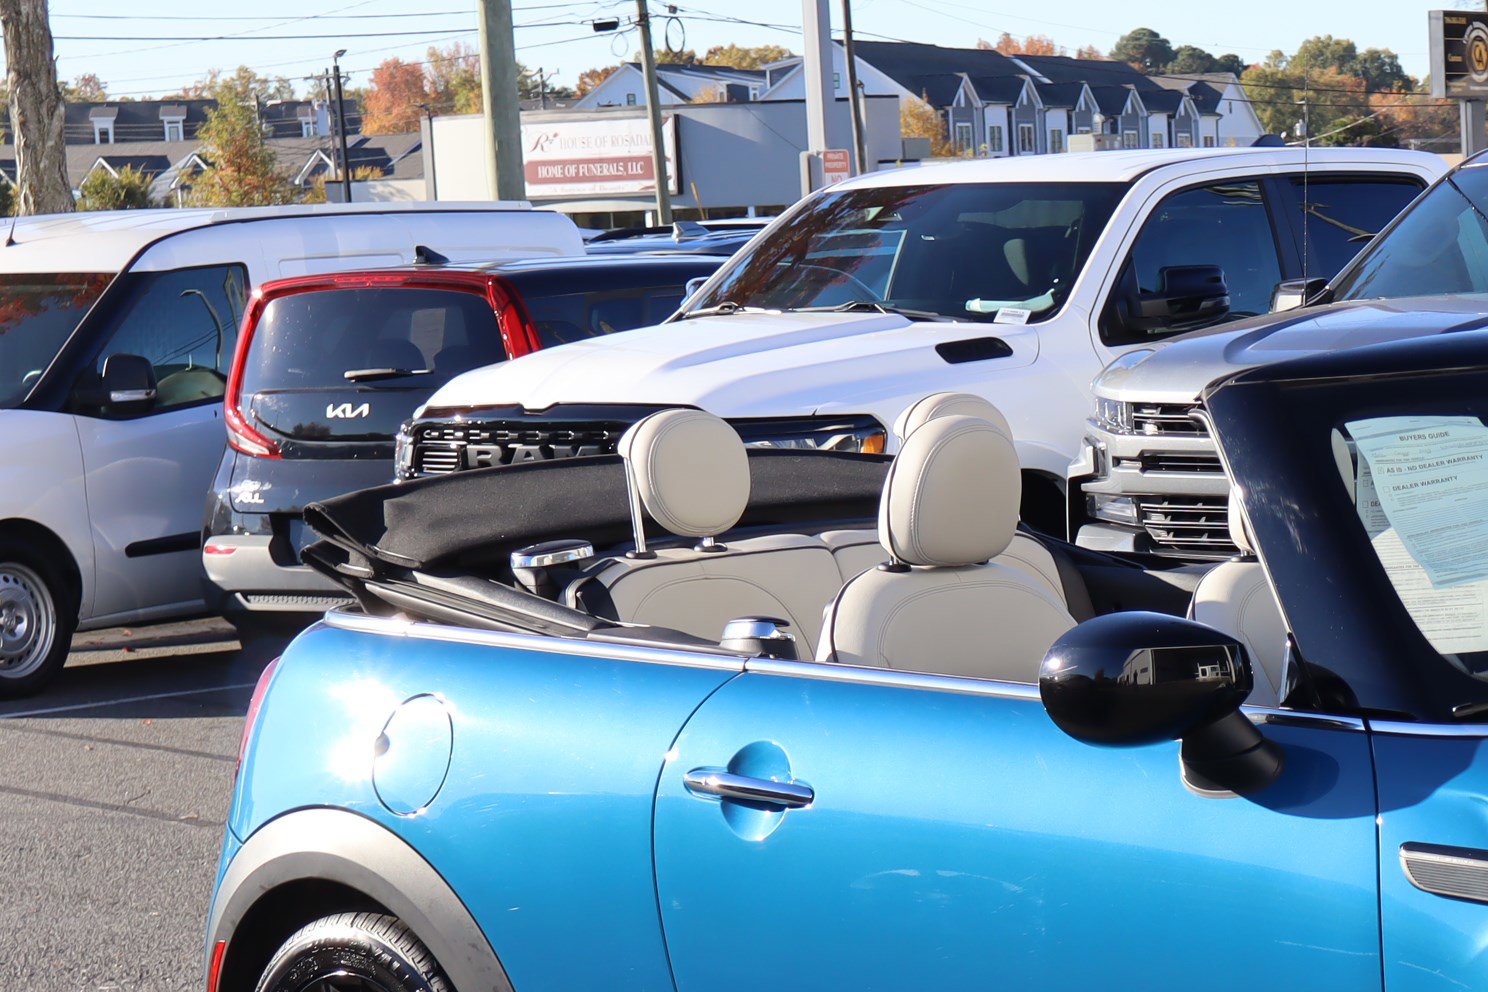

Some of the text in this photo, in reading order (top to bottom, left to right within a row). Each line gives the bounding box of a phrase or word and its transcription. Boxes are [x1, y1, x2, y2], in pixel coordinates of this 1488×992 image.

[560, 136, 592, 150] HOUSE
[594, 136, 608, 149] OF
[538, 161, 645, 178] HOME OF FUNERALS, LLC
[1399, 430, 1450, 442] BUYERS GUIDE
[1420, 460, 1446, 470] DEALER
[1447, 454, 1484, 465] WARRANTY
[1392, 475, 1458, 492] DEALER WARRANTY
